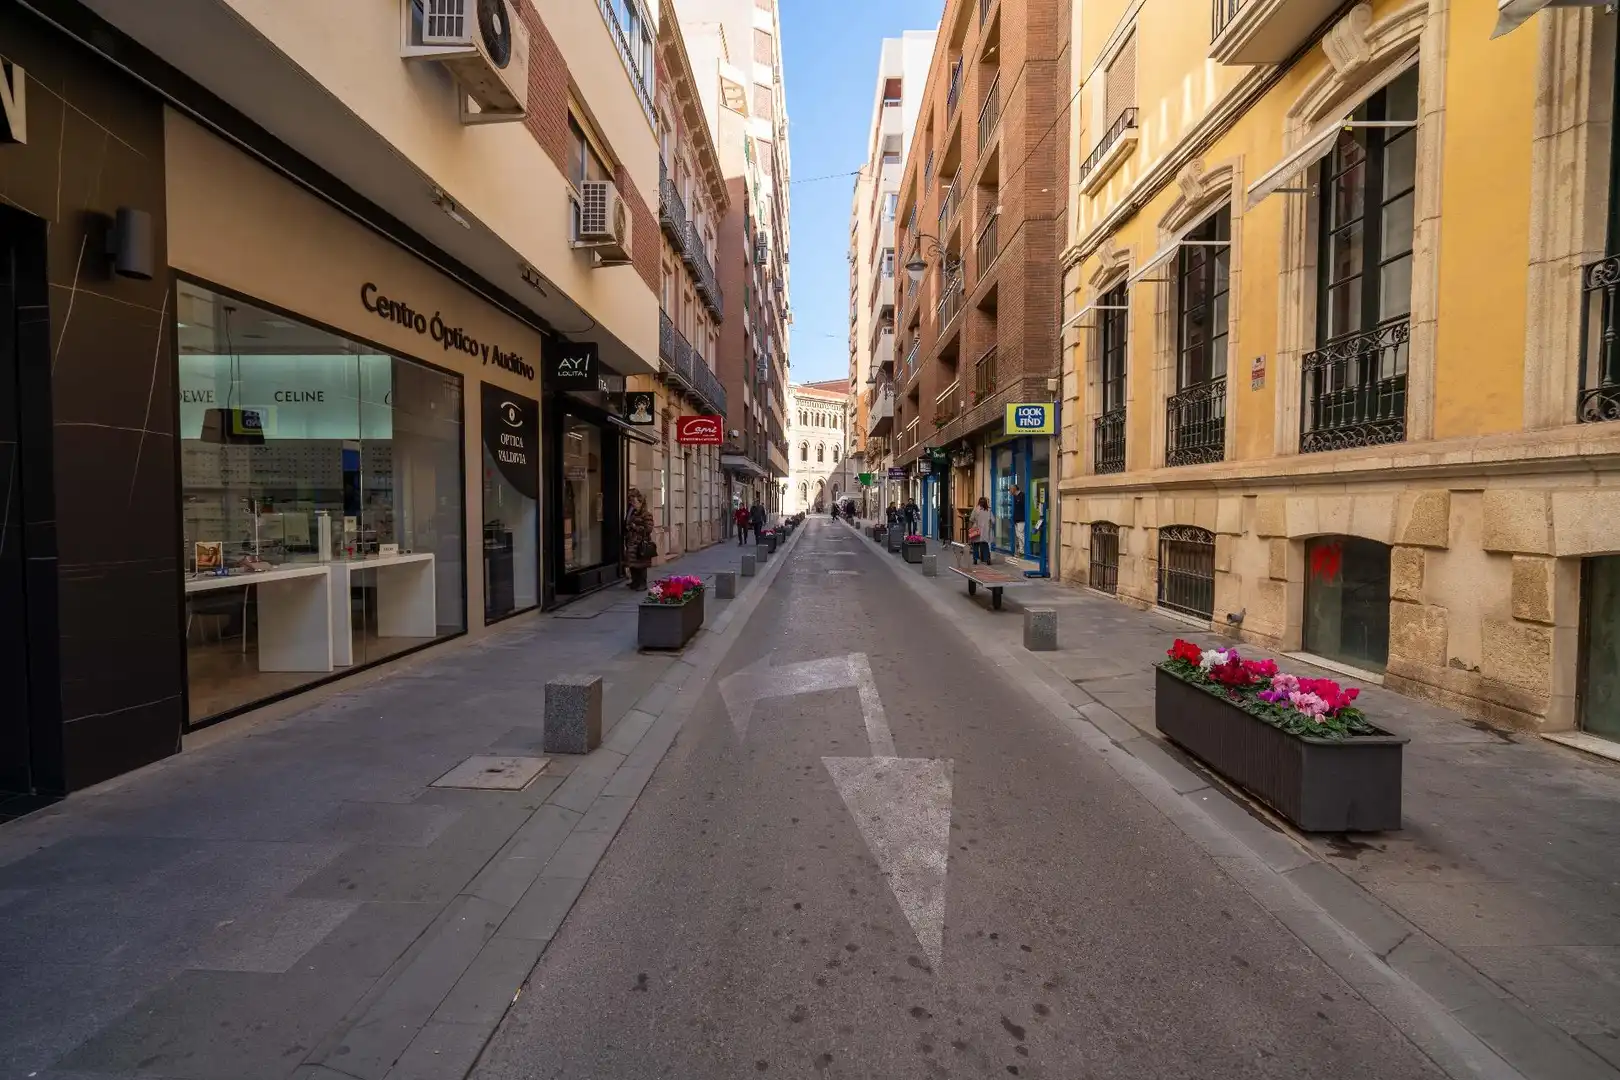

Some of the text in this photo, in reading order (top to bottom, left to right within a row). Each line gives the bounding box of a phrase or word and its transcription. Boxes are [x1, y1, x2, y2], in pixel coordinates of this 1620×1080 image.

[361, 282, 535, 381] Centro Óptico y Auditivo
[274, 391, 325, 402] CELINE
[1018, 407, 1042, 416] LOOK
[683, 418, 718, 436] Capri
[1020, 418, 1041, 426] FIND
[500, 433, 524, 448] OPTICA
[498, 449, 527, 465] VALDIVIA
